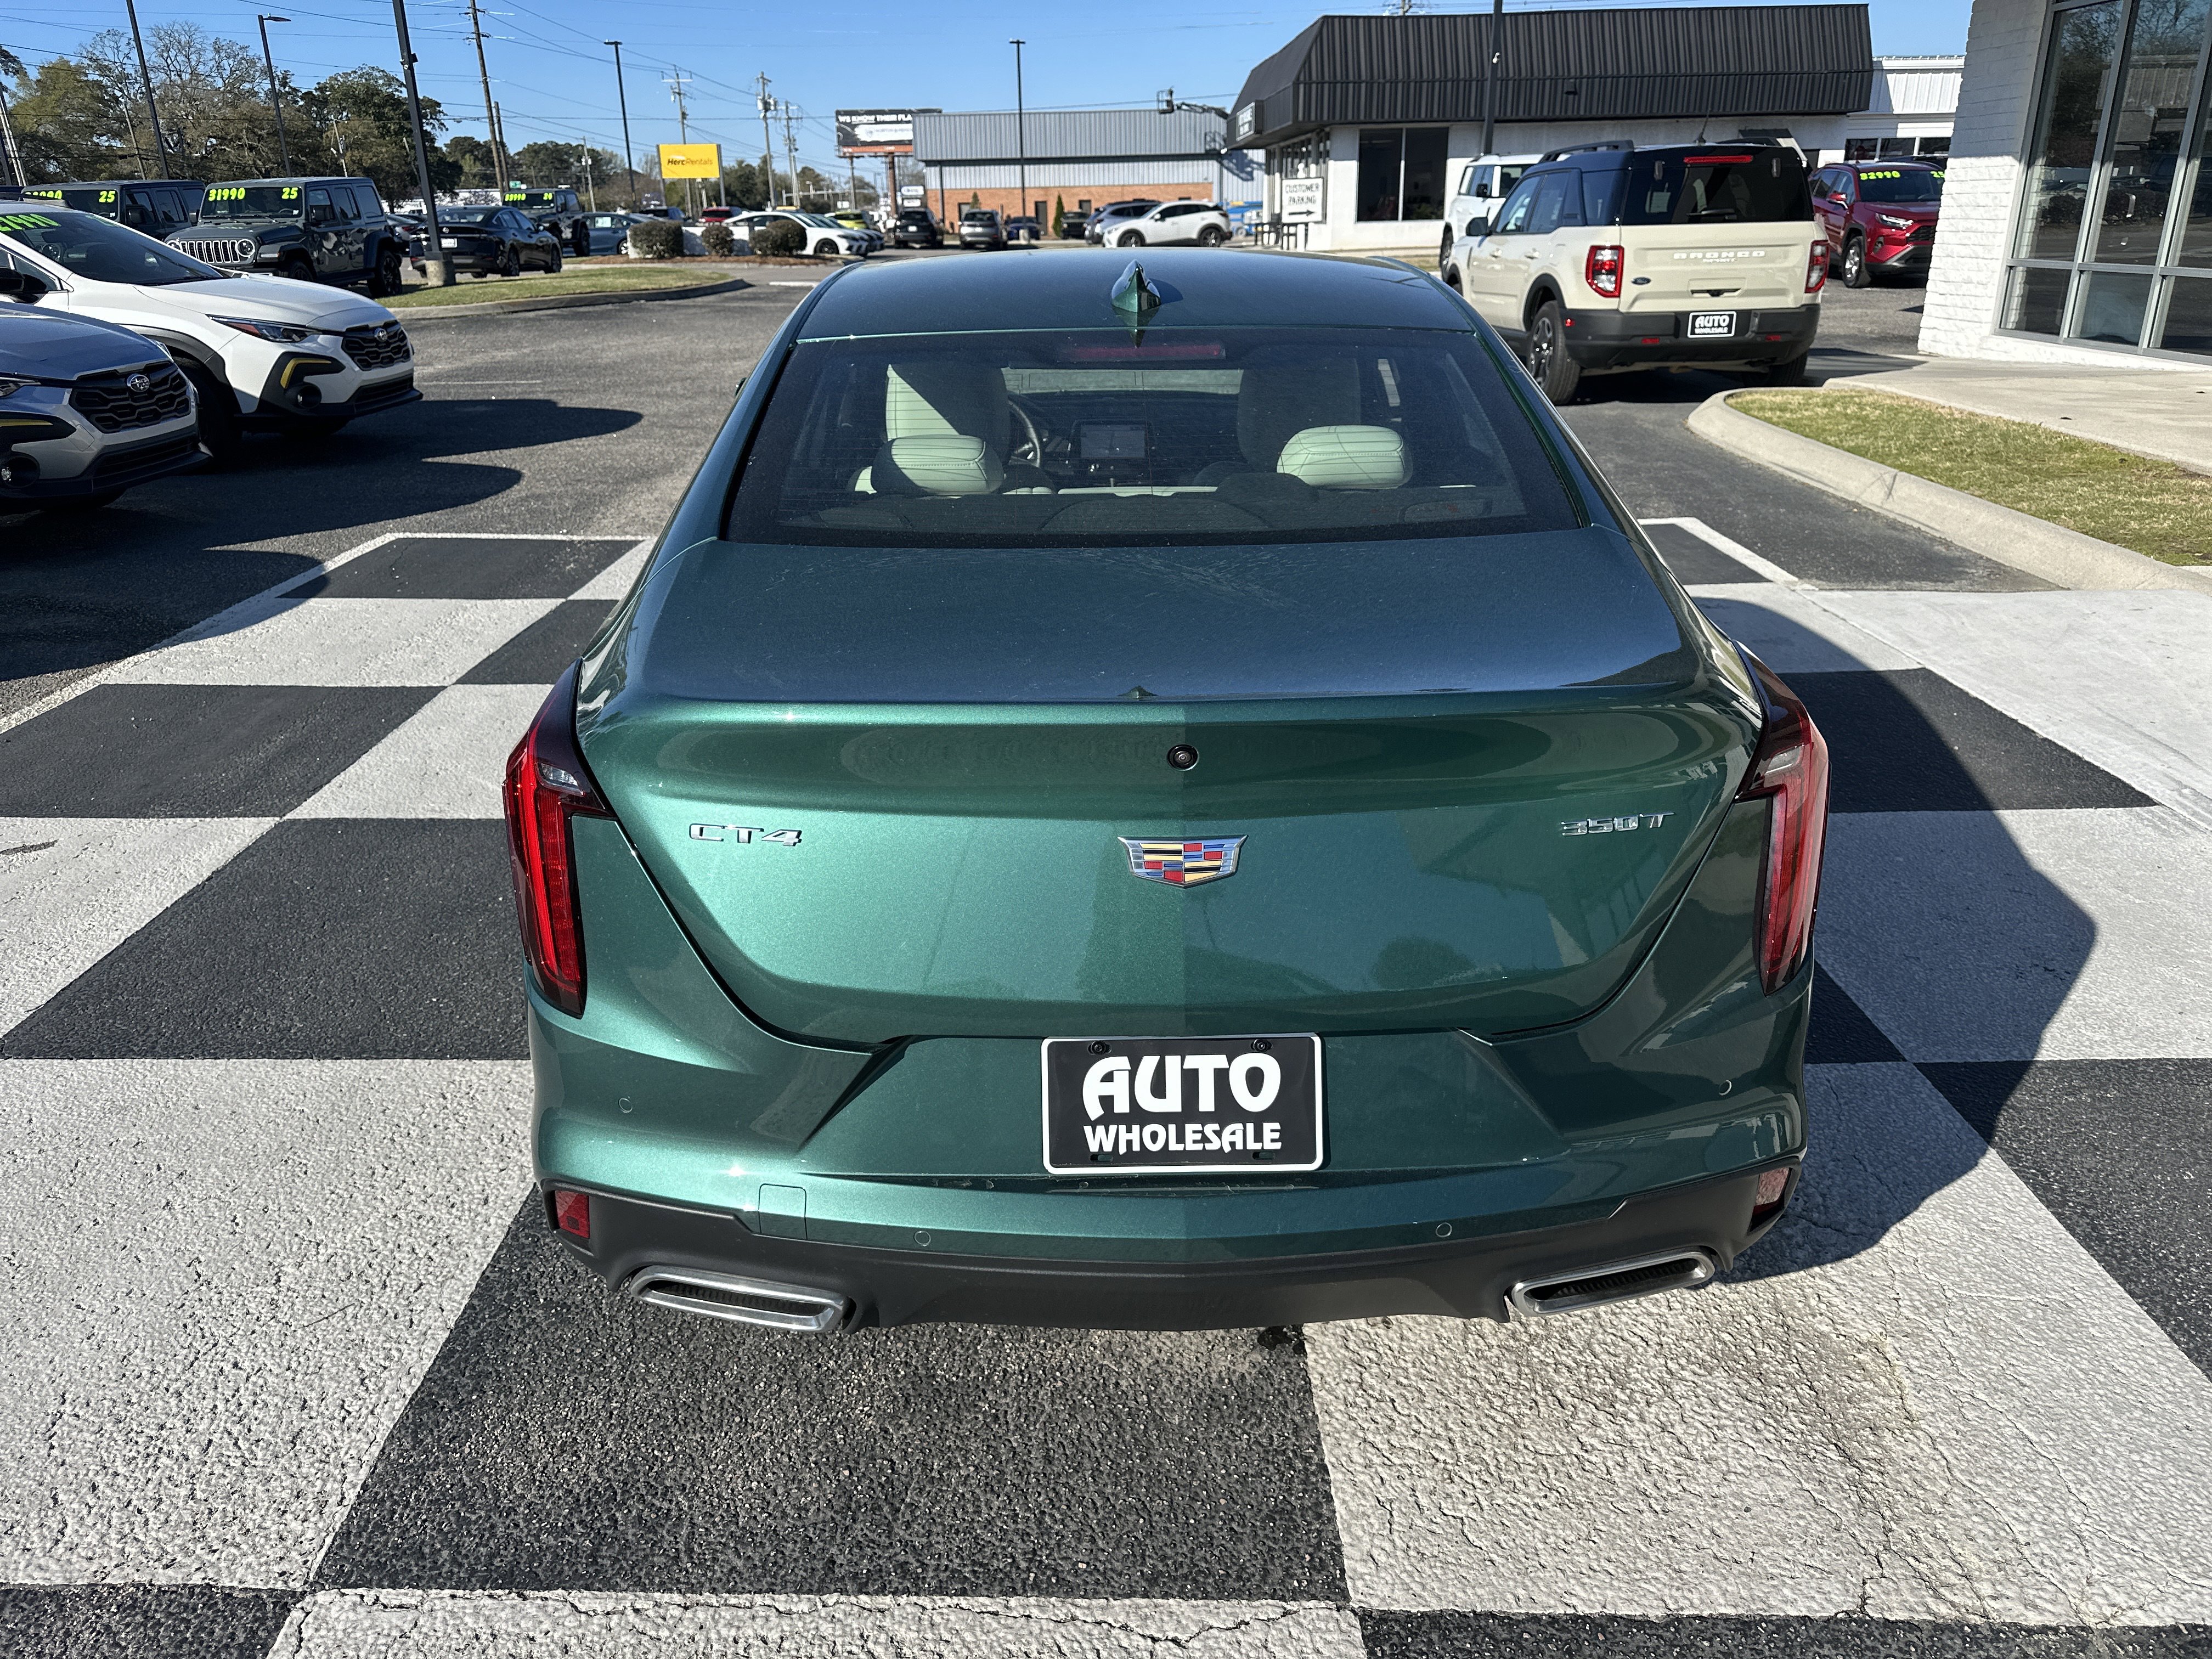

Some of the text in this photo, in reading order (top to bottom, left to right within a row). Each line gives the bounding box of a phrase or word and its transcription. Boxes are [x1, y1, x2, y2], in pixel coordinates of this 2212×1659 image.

[1859, 171, 1900, 180] 32990
[208, 187, 298, 201] 31990 25
[1285, 183, 1319, 193] CUSTOMER
[99, 190, 116, 202] 25
[1288, 195, 1317, 205] PARKING
[1673, 251, 1765, 259] BRONCO
[1695, 315, 1730, 328] AUTO
[1561, 811, 1675, 836] 350T
[689, 823, 802, 847] CT4
[1082, 1052, 1281, 1121] AUTO
[1083, 1122, 1282, 1155] WHOLESALE
